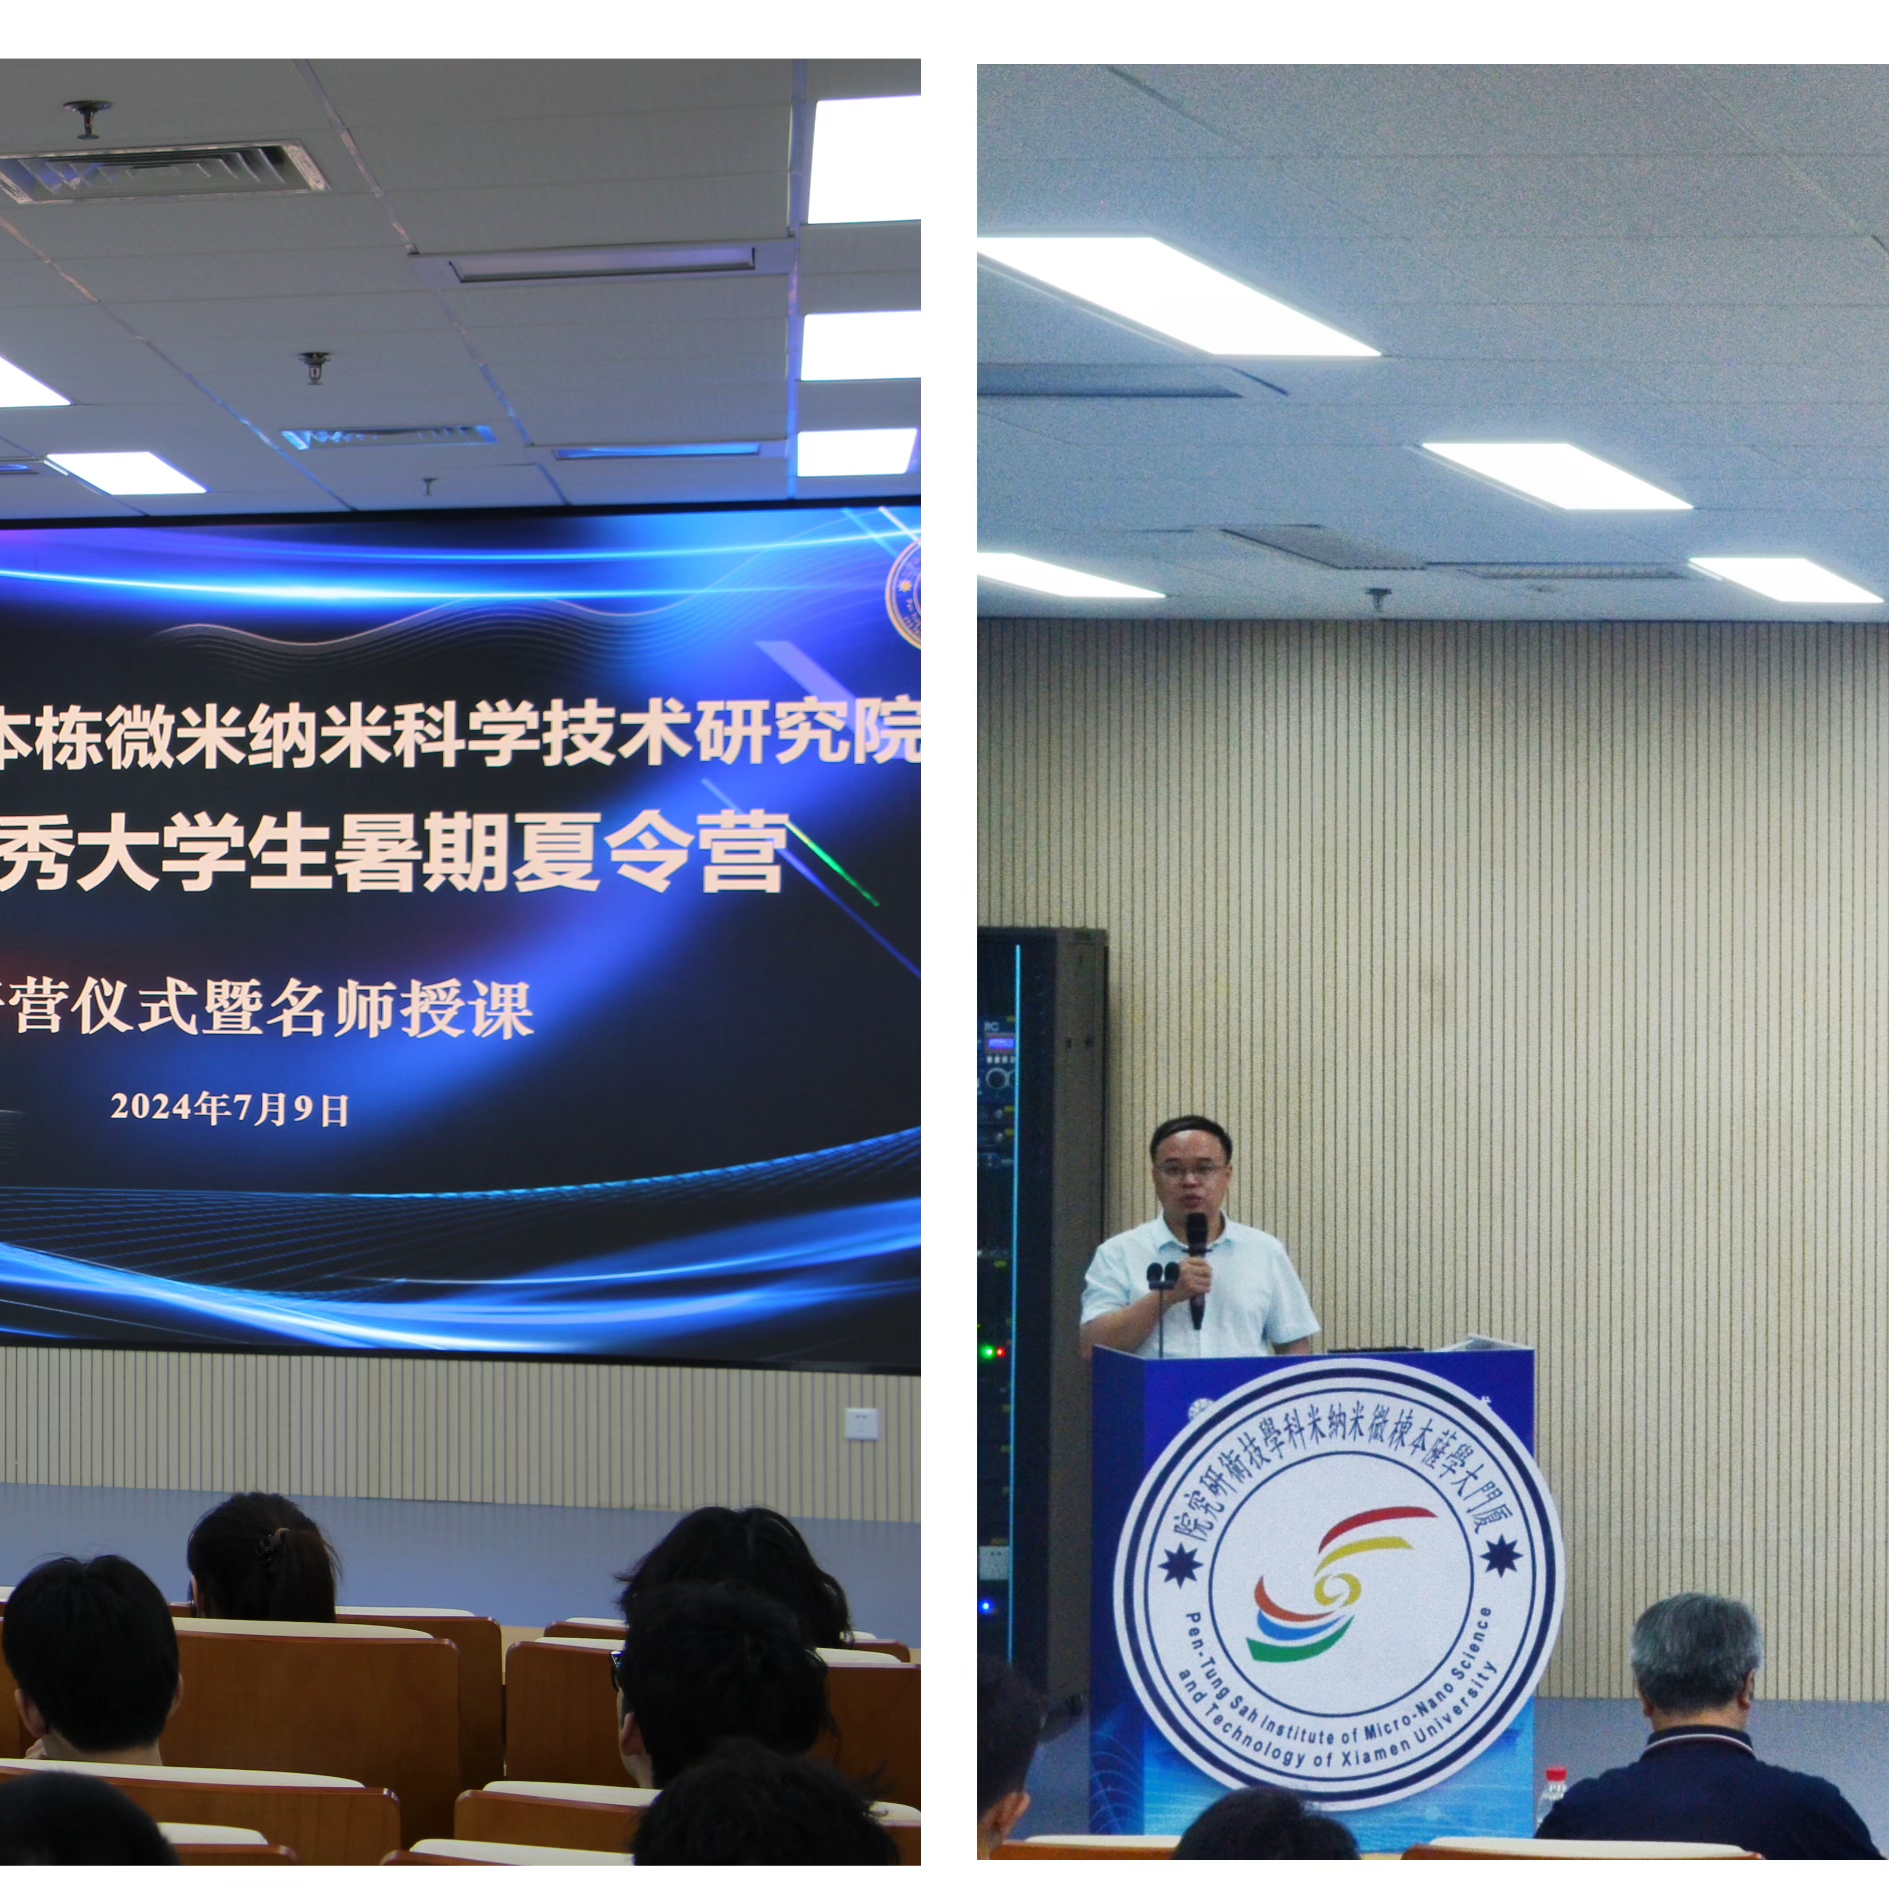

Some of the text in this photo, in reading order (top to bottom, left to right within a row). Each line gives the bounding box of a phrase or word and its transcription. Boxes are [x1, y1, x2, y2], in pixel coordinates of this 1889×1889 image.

[110, 1090, 350, 1128] 2024年7月9日
[1179, 1660, 1498, 1768] and Technology of Xiamen University
[1186, 1606, 1492, 1745] Pen-Tung Sah Institute of Micro-Nano Science
